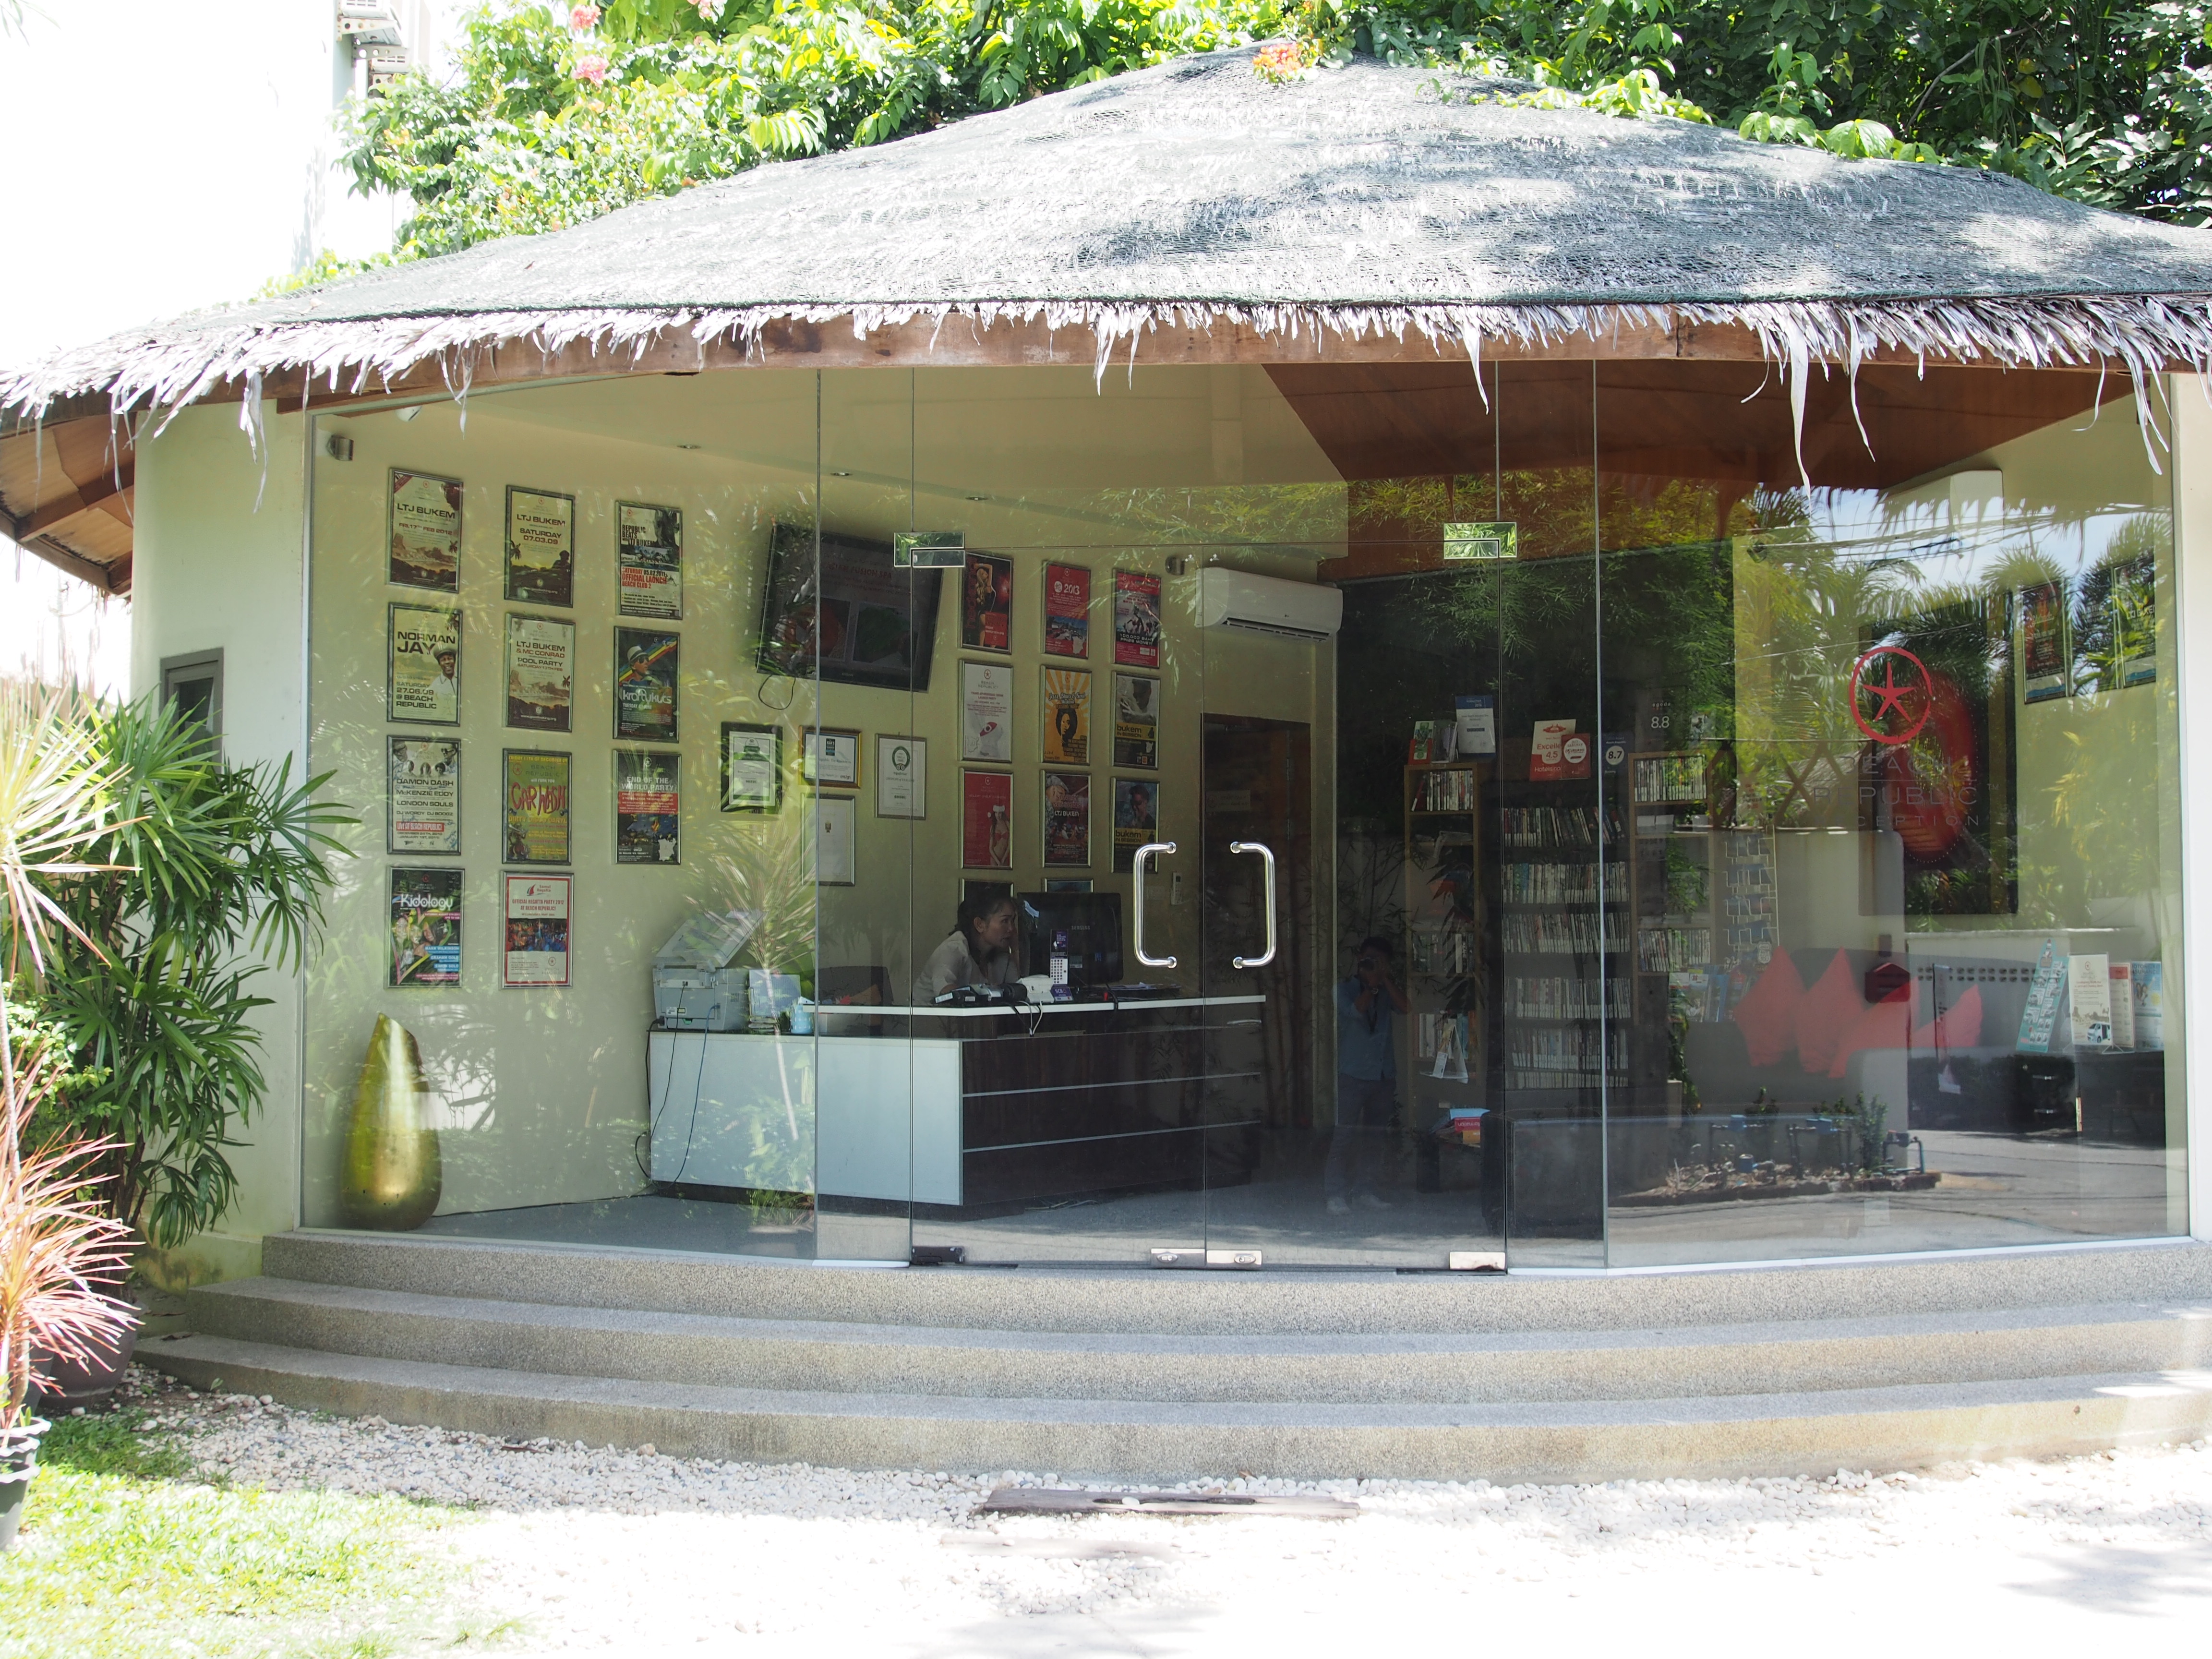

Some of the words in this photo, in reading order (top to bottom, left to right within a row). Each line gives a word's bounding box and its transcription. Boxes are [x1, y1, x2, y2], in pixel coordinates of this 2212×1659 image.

[397, 503, 414, 512] LTJ
[417, 506, 455, 519] BUKEM
[533, 516, 565, 527] BUKEM
[520, 528, 562, 539] SATURDAY
[622, 524, 646, 533] REPUBLIC
[523, 535, 558, 544] 07.03.09
[622, 531, 638, 539] BEATS
[636, 539, 656, 547] BUKEM
[622, 567, 643, 575] SATURDAY
[622, 573, 645, 583] OFFICIAL
[646, 576, 667, 585] LAUNCH
[1064, 583, 1080, 595] 2013
[397, 631, 455, 644] NORMAN
[397, 641, 436, 655] JAY
[533, 643, 565, 652] BUKEM
[1117, 723, 1142, 733] bukem
[1651, 716, 1670, 729] 8.8
[1608, 751, 1623, 759] 8.7
[1838, 756, 1951, 774] BEACH
[511, 782, 537, 811] CAR
[537, 784, 566, 816] WASH
[1814, 787, 1977, 805] REPUBLIC
[405, 822, 409, 830] AT
[410, 822, 423, 831] BEACH
[1115, 829, 1142, 838] bukem
[400, 893, 453, 911] Kidology
